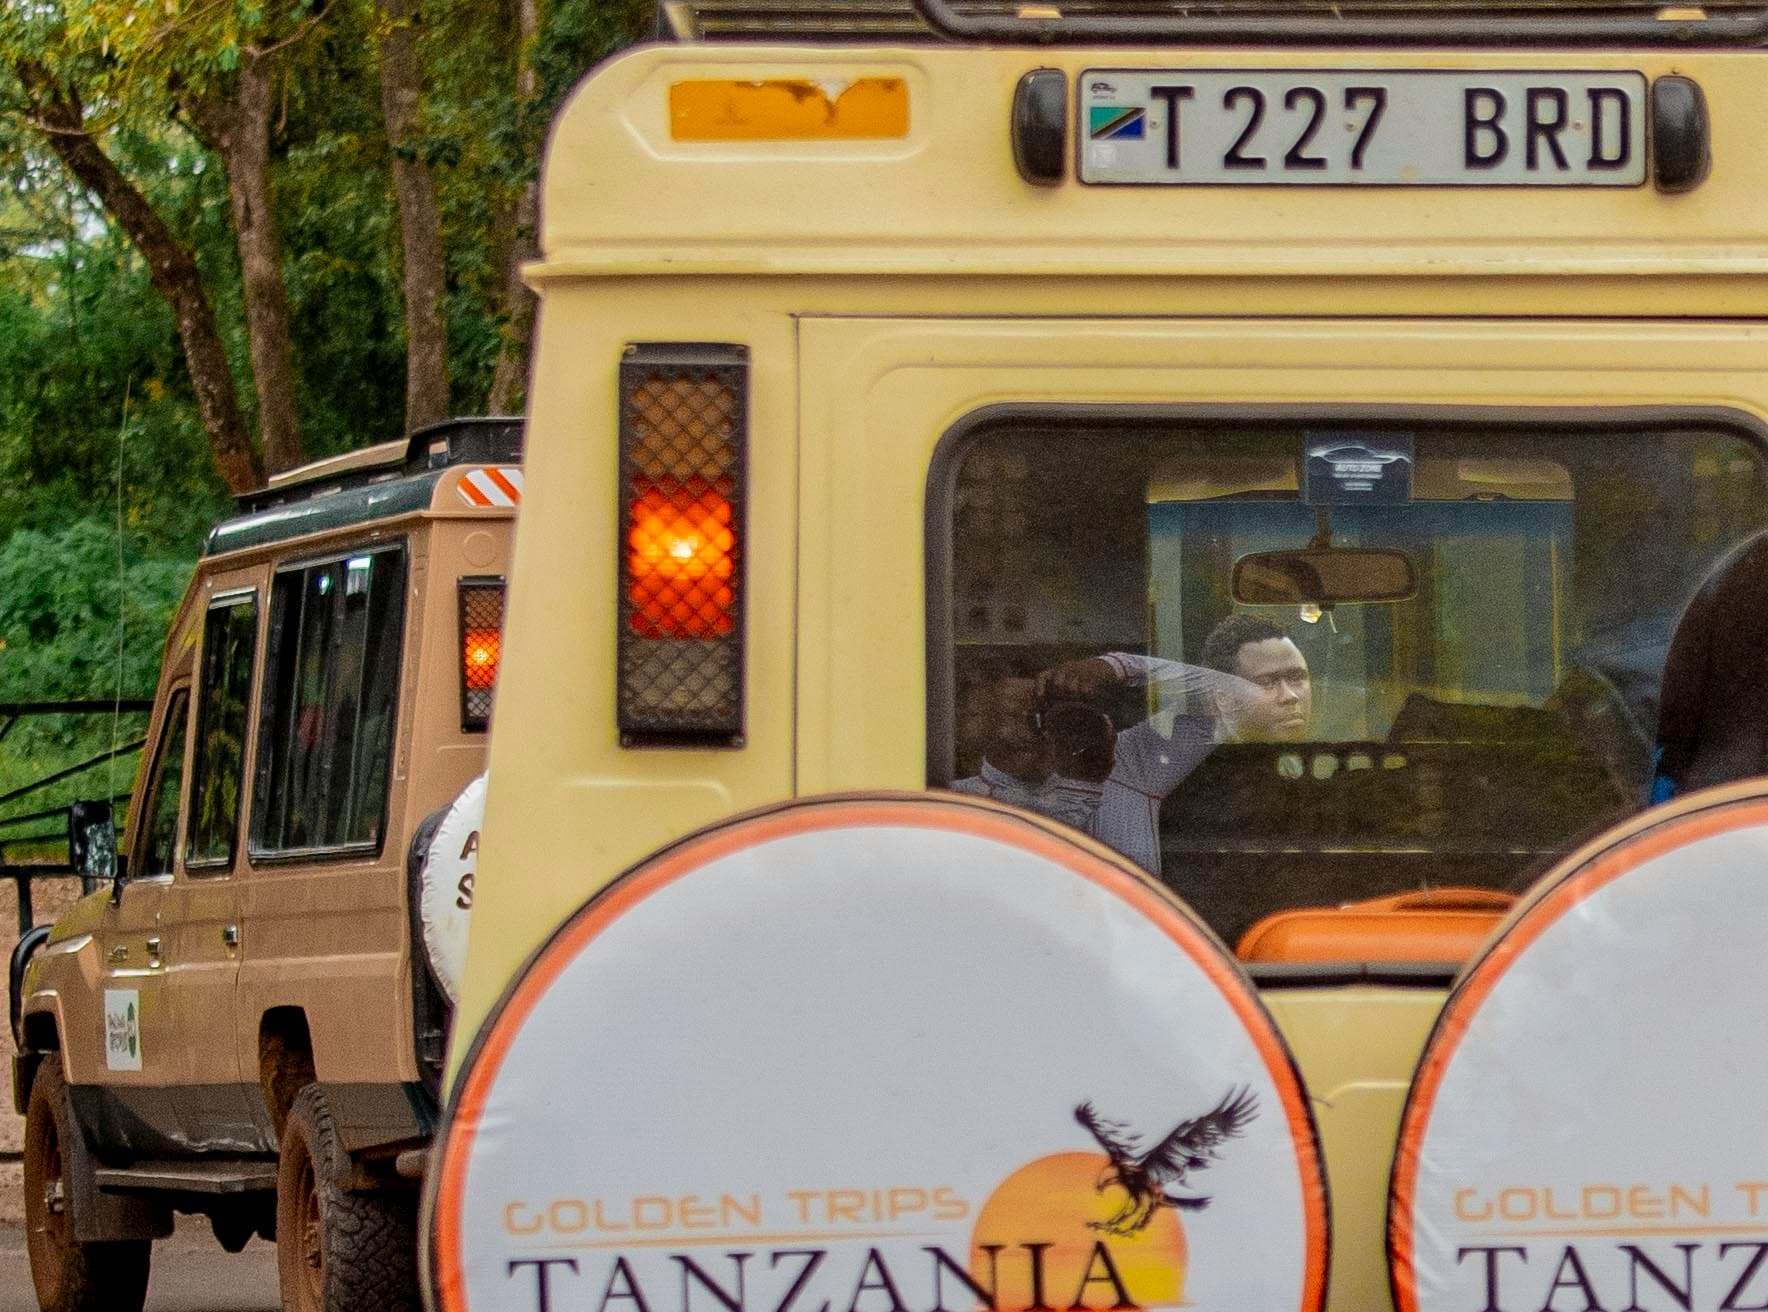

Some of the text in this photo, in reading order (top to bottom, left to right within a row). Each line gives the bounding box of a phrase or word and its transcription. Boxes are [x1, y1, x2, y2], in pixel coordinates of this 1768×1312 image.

[1149, 86, 1633, 172] T 227 BRD
[503, 1186, 969, 1236] GOLDEN TRIPS
[1453, 1182, 1712, 1223] GOLDEN
